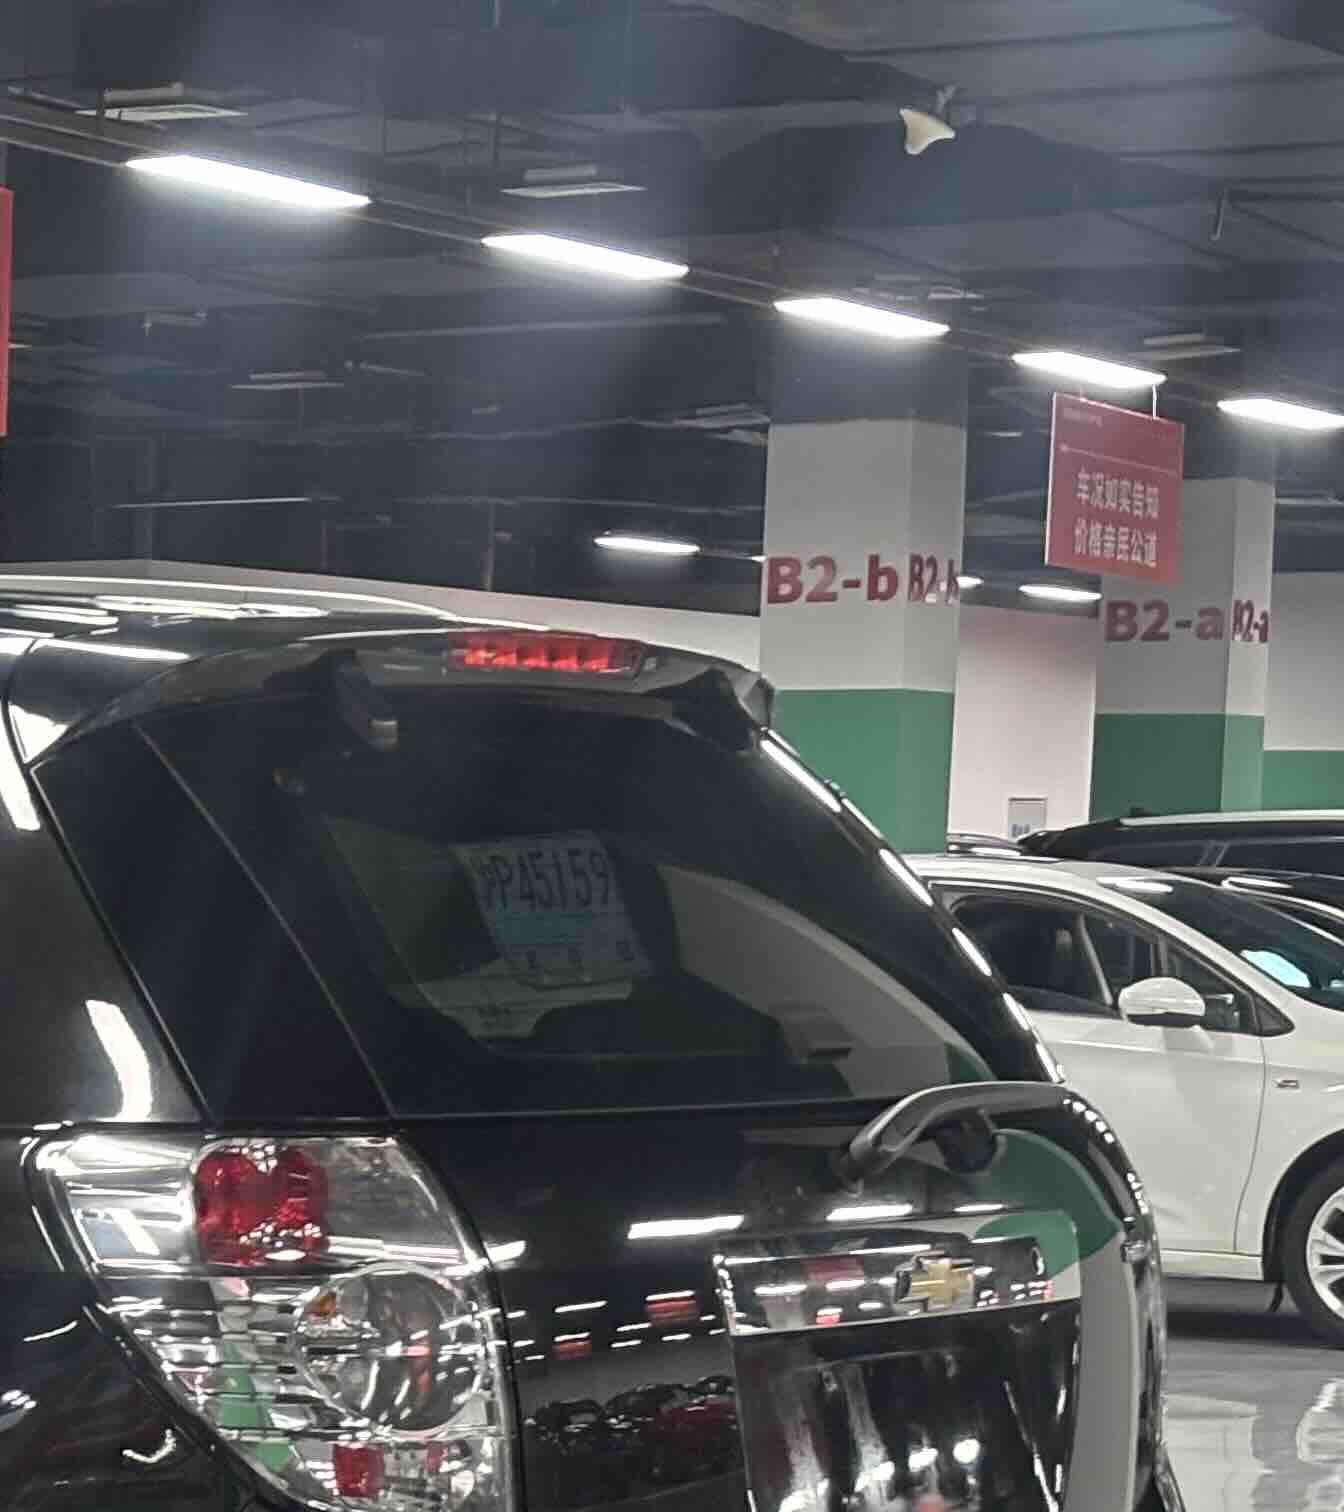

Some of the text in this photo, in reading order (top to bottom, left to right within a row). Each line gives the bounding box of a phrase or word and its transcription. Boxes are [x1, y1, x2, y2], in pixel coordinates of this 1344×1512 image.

[1075, 467, 1160, 520] 车况如实告知
[1074, 516, 1158, 569] 价格亲民公道
[767, 553, 899, 604] B2-b
[1103, 600, 1225, 642] B2-a
